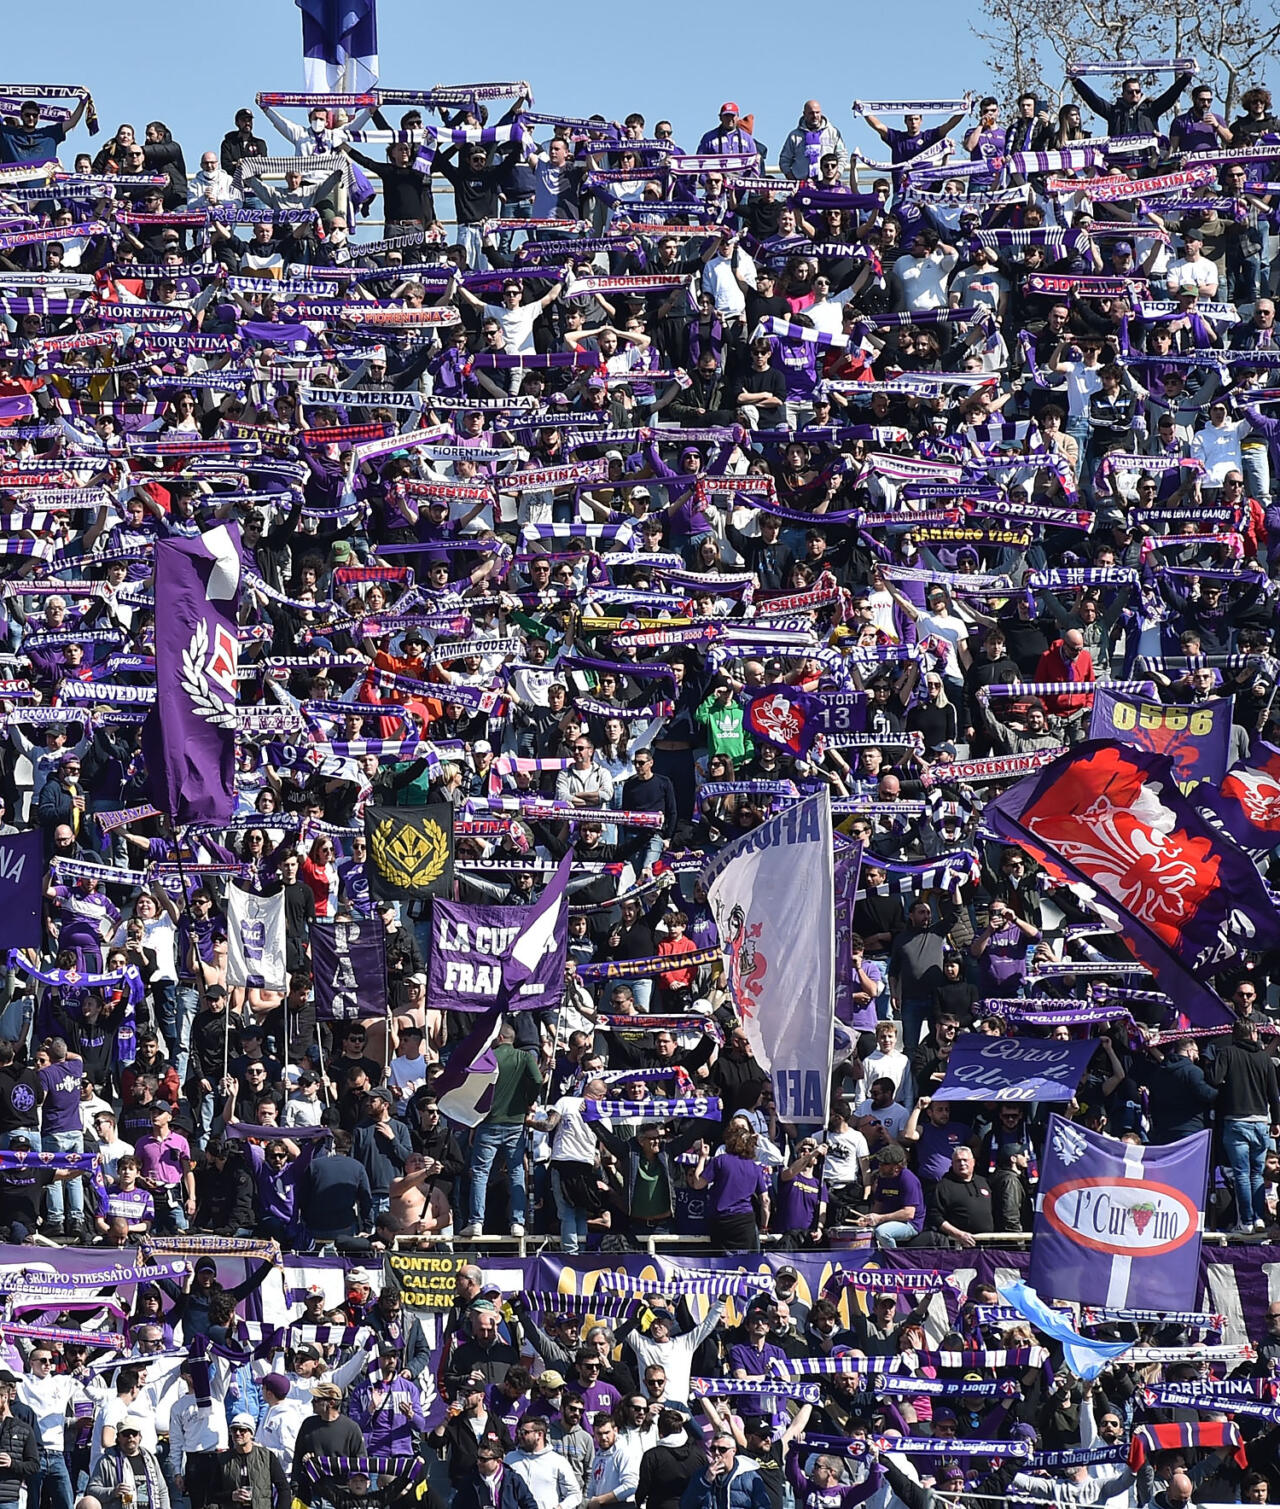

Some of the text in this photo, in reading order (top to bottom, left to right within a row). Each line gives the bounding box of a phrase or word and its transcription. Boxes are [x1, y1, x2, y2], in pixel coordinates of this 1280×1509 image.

[16, 185, 91, 199] FIORENTINA
[1109, 172, 1196, 199] FIORENTINA
[6, 226, 86, 246] FIORENTINA
[350, 231, 424, 257] COLLETTIVO
[541, 240, 612, 253] FIORENTINA
[116, 263, 219, 278] FIORENTINA
[230, 276, 337, 296] JUVE MERDA
[420, 276, 448, 286] Firenze
[99, 306, 184, 320] FIORENTINA
[365, 310, 441, 321] FIORENTINA
[140, 335, 230, 351] FIORENTINA
[149, 375, 173, 387] ACF
[307, 391, 416, 408] JUVE MERDA
[428, 398, 531, 410] FIORENTINA
[512, 411, 600, 425] ACF FIORENTINA
[303, 422, 386, 443] FIORENTINA
[431, 447, 500, 457] FIORENTINA
[18, 458, 108, 471] COLLETTIVO
[1108, 455, 1181, 470] FIORENTINA
[409, 481, 488, 499] FIORENTINA
[918, 484, 981, 496] FIORENTINA
[976, 498, 1080, 524] FIORENZA
[45, 545, 143, 575] JUVE MERDA
[380, 618, 451, 631] FIORENTINA
[434, 636, 518, 660] FAMMI GODERE
[106, 654, 142, 670] ngrato
[103, 712, 129, 724] FORZA
[819, 693, 860, 729] STORI 13
[716, 730, 742, 740] adidas
[826, 736, 912, 748] FIORENTINA
[948, 755, 1042, 779] FIORENTINA
[606, 945, 724, 980] AFICIONADOS
[596, 1097, 709, 1118] ULTRAS
[391, 1256, 451, 1272] CONTRO
[24, 1262, 170, 1287] GRUPPO STRESSATO VIOLA
[403, 1275, 457, 1290] CALCIO
[843, 1269, 943, 1286] FIORENTINA
[597, 1393, 611, 1407] 10
[1212, 1397, 1273, 1417] Sbagliare
[894, 1437, 1007, 1455] Liberi di Sbagliare
